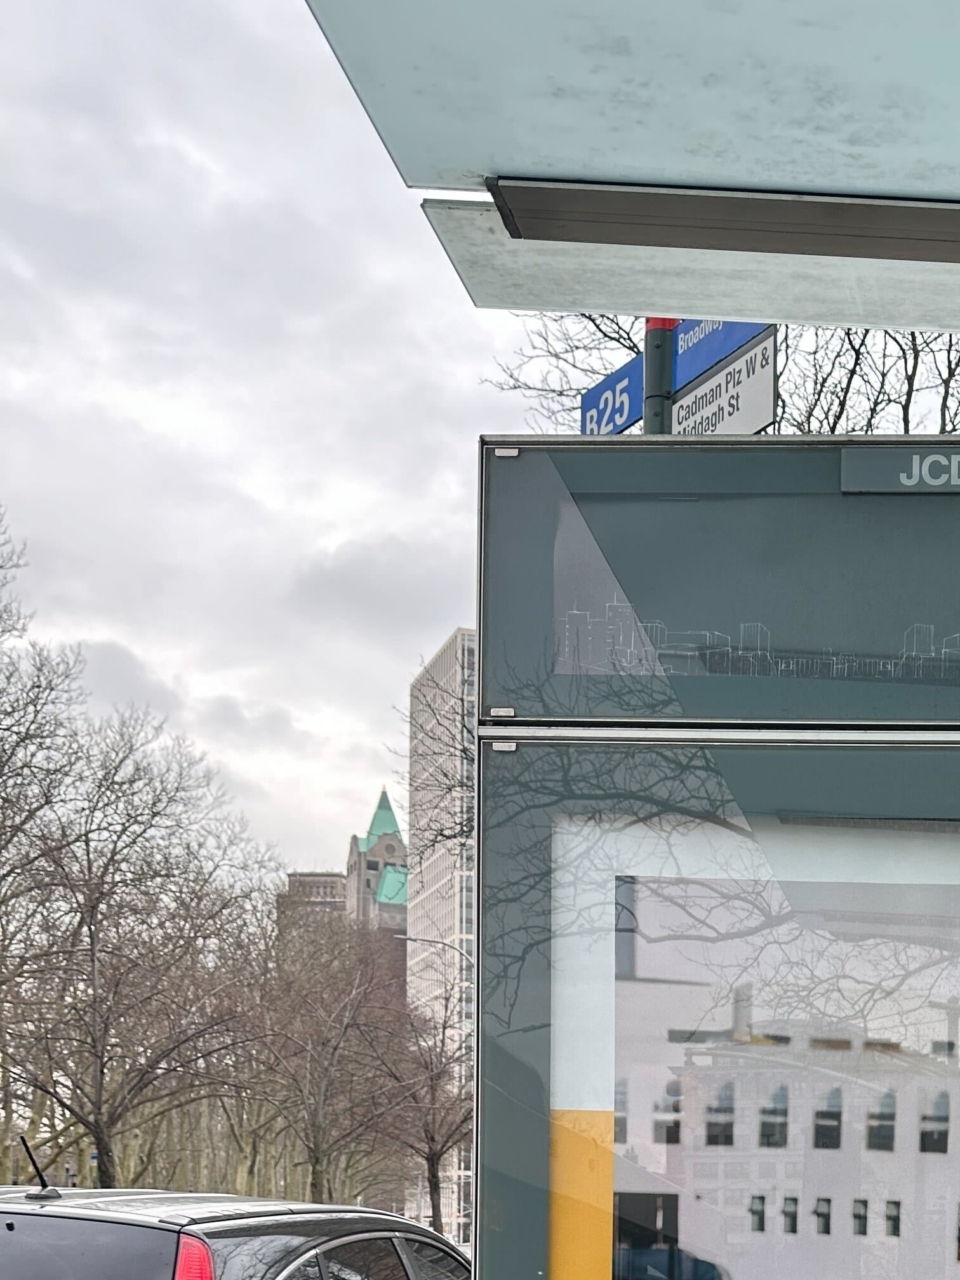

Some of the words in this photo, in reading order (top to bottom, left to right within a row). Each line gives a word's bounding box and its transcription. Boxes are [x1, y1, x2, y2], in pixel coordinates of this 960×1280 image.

[586, 377, 630, 434] B25
[677, 387, 722, 426] Cadman
[725, 369, 742, 393] Plz
[745, 358, 758, 379] W
[760, 346, 770, 368] &
[727, 391, 740, 417] St
